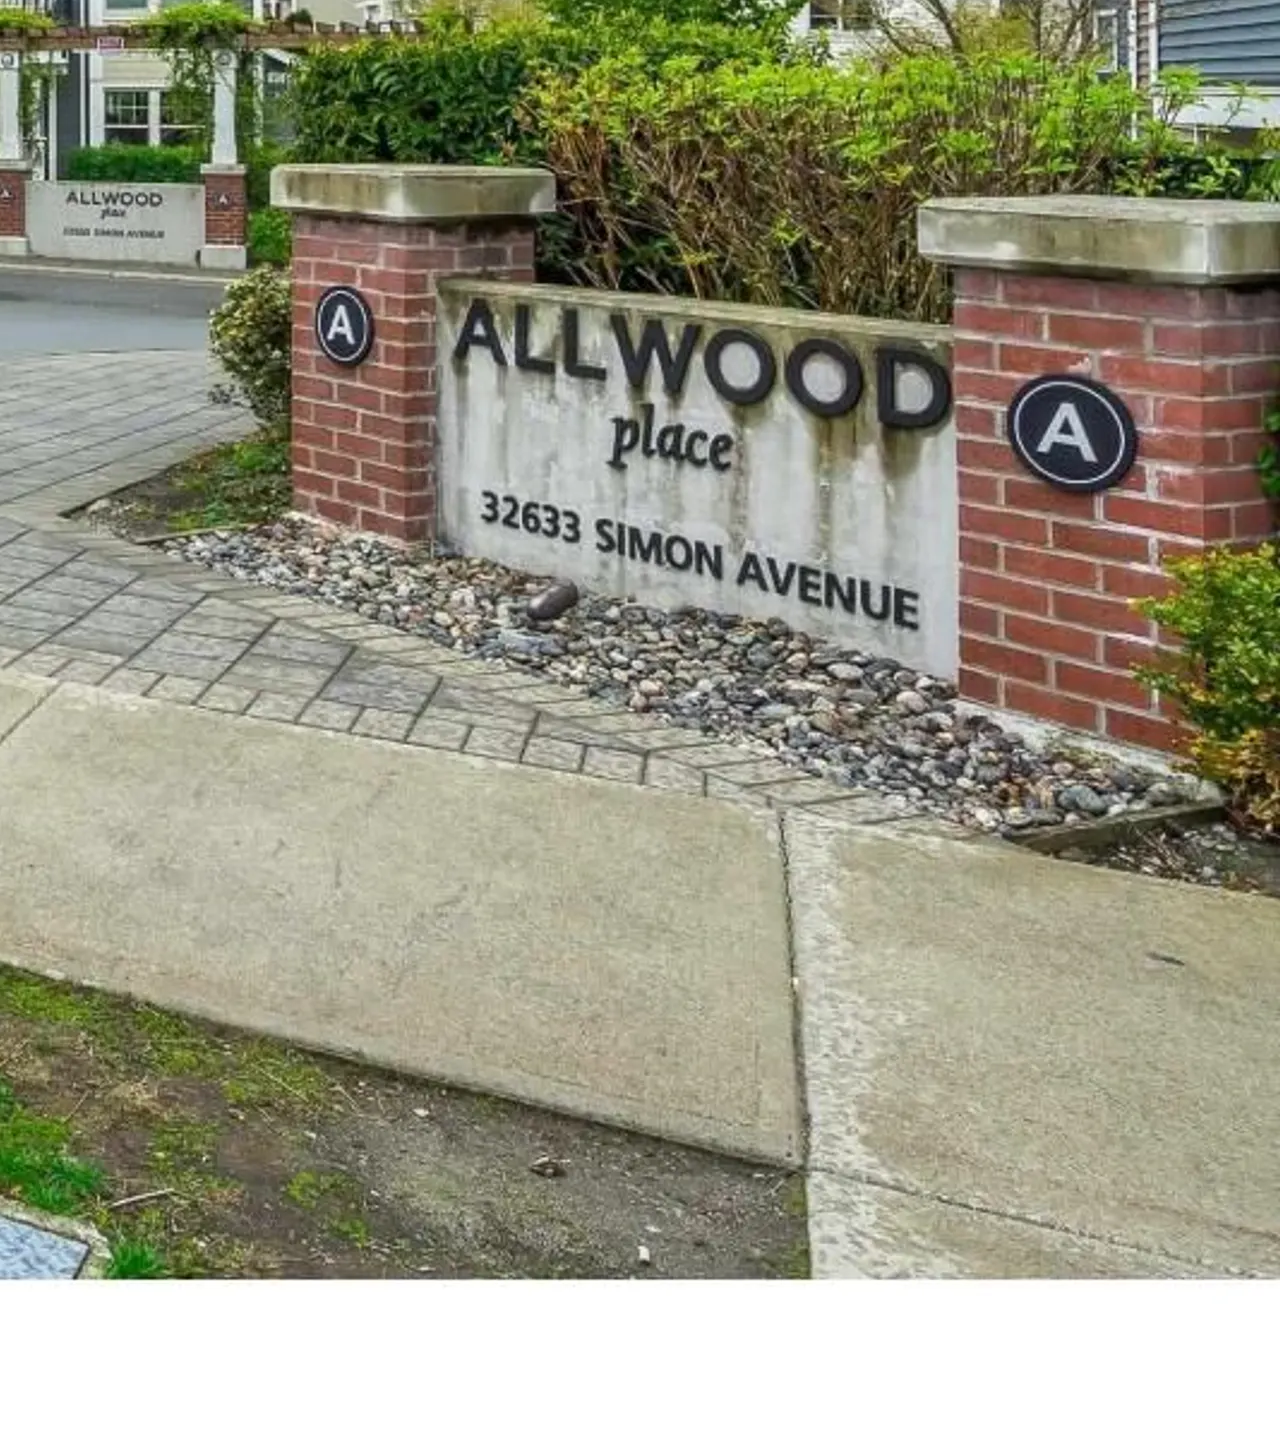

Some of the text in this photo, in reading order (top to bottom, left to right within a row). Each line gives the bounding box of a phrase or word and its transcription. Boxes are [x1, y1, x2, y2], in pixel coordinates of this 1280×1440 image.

[66, 191, 163, 207] ALLWOOD
[453, 298, 953, 430] ALLWOOD
[606, 404, 734, 472] place
[1037, 403, 1098, 463] A
[480, 491, 921, 631] 32633 SIMON AVENUE
